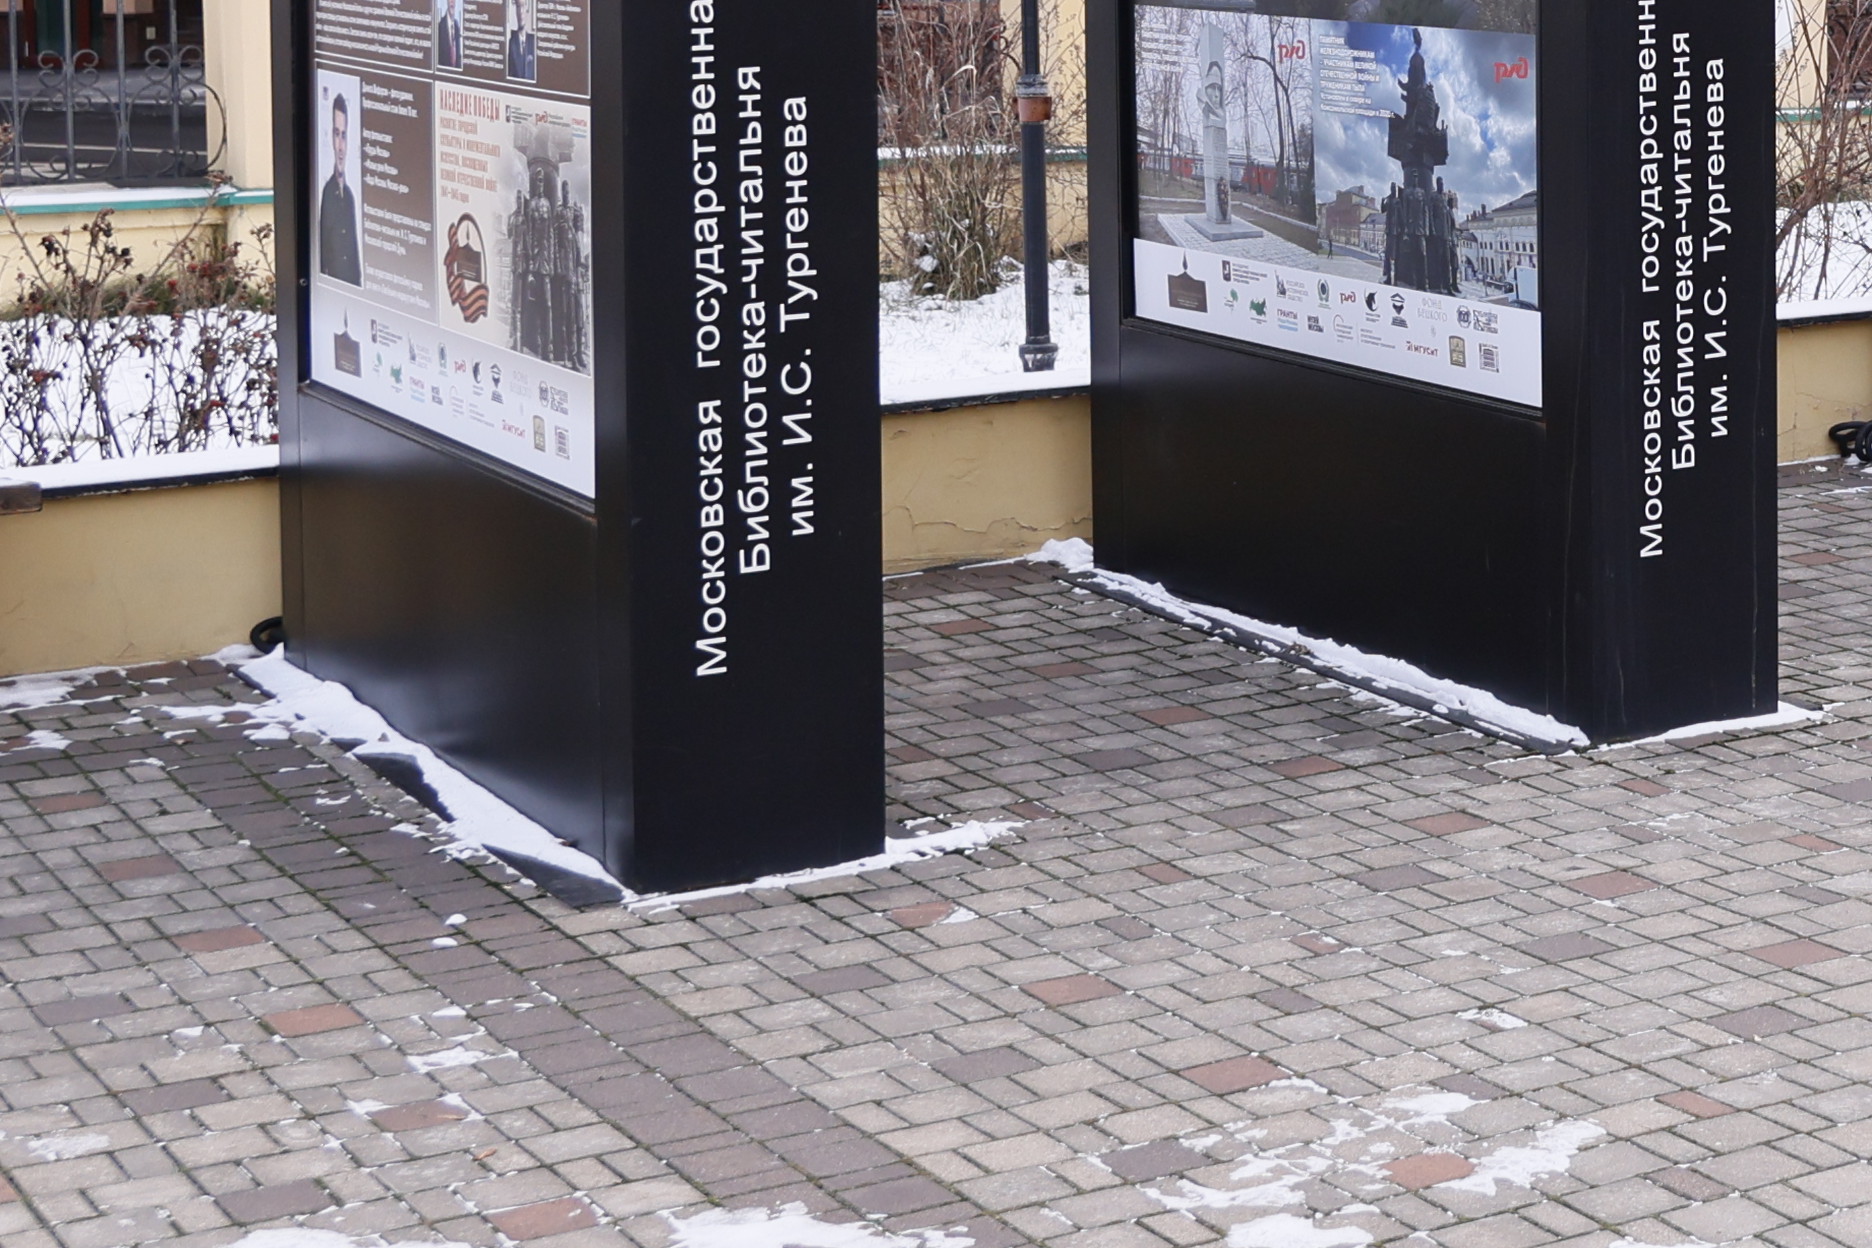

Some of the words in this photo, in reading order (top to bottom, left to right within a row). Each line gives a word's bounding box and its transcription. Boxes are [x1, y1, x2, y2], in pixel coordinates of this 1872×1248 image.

[779, 94, 818, 333] Тургенева
[1671, 31, 1696, 471] Библиотека-читальня
[1703, 56, 1732, 262] Тургенева
[736, 64, 771, 575] Библиотека-читальня
[781, 348, 813, 445] И.С.
[1704, 274, 1728, 360] И.С.
[1711, 373, 1729, 438] им.
[694, 398, 728, 677] Московская
[792, 462, 815, 537] им.
[1639, 318, 1663, 558] Московская
